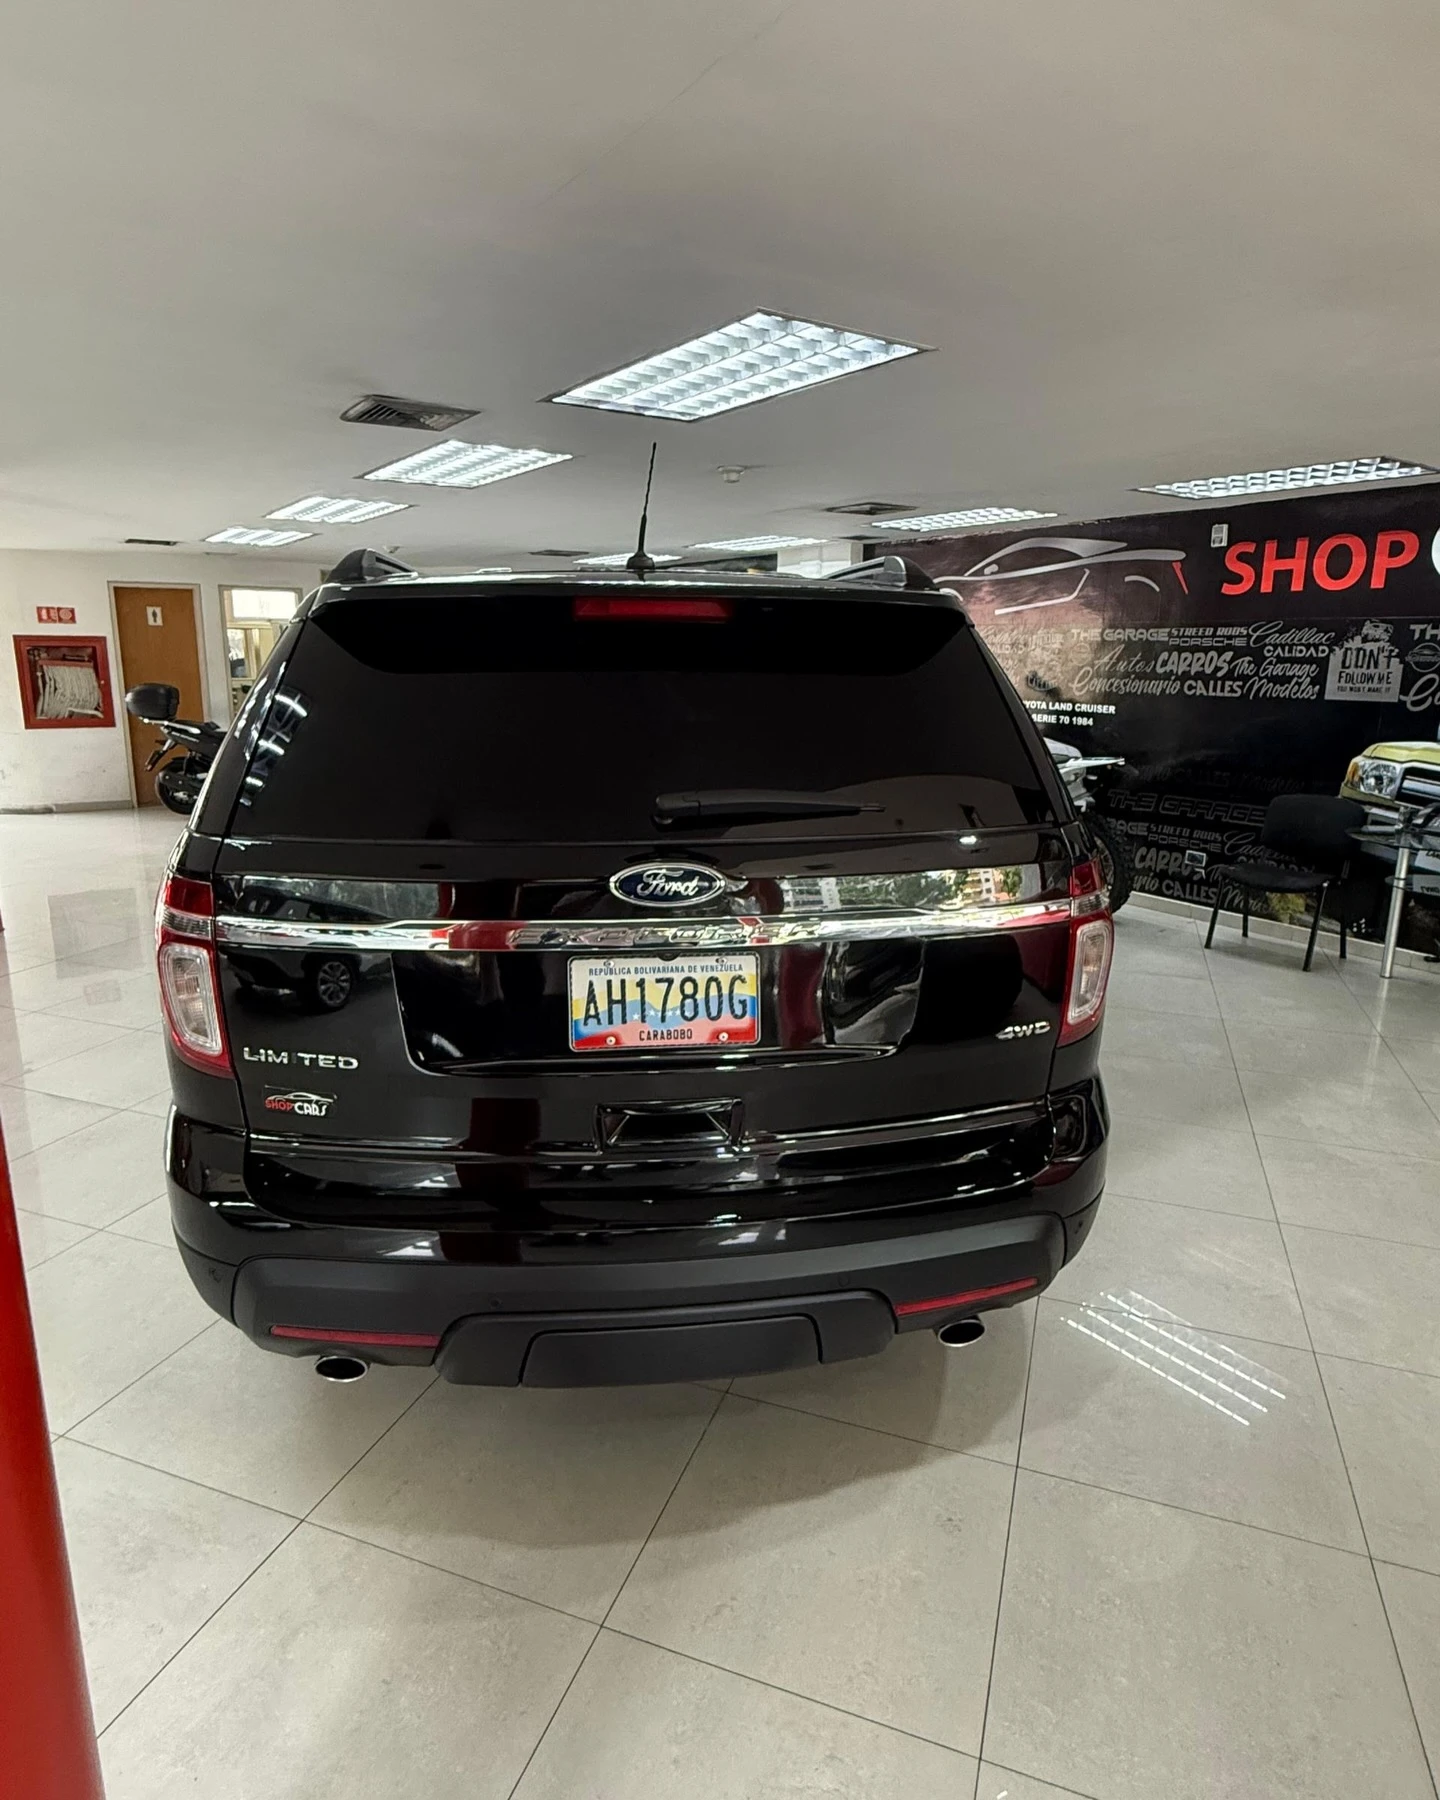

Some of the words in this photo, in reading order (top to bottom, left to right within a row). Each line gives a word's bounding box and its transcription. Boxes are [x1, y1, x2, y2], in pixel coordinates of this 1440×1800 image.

[1220, 529, 1420, 596] SHOP
[1070, 628, 1101, 642] THE
[1103, 627, 1170, 642] GARAGE
[1216, 626, 1249, 636] RODS
[1248, 620, 1336, 648] Cadillac
[1168, 637, 1248, 647] PORSCHE
[1263, 645, 1330, 658] CALIDAD
[1093, 644, 1156, 674] Autos
[1155, 650, 1235, 678] CARROS
[1229, 656, 1258, 678] The
[1258, 658, 1320, 682] Garage
[1068, 666, 1182, 697] Concesionario
[1183, 680, 1243, 698] CALLES
[1243, 676, 1321, 701] Modelos
[1337, 670, 1377, 685] FOLLOW
[1022, 701, 1048, 710] YOTA
[1048, 701, 1073, 712] LAND
[1074, 703, 1116, 715] CRUISER
[1058, 715, 1070, 725] 70
[1072, 716, 1094, 726] 1984
[636, 868, 700, 897] Ford
[1161, 878, 1218, 905] CALLES
[634, 965, 685, 975] BOLIVARIANA
[687, 965, 697, 973] DE
[701, 963, 743, 973] VENEZUELA
[583, 973, 748, 1026] AH1780G
[639, 1028, 693, 1041] CARABOBO
[995, 1021, 1051, 1040] 4WD
[243, 1047, 359, 1069] LIMITED
